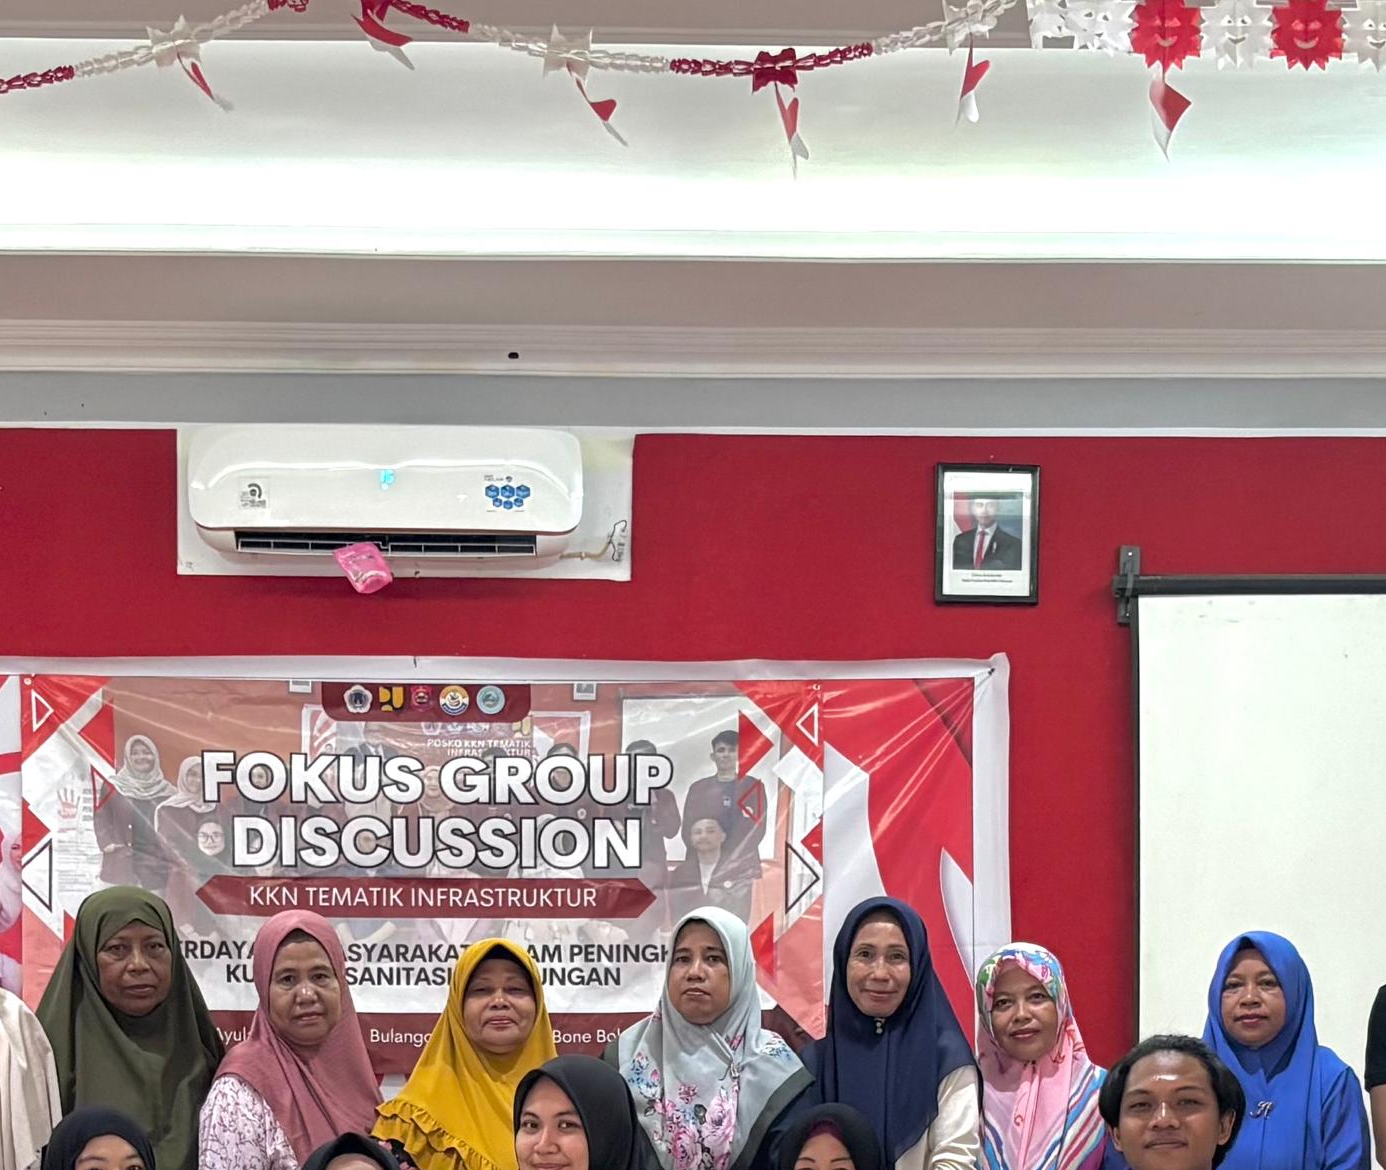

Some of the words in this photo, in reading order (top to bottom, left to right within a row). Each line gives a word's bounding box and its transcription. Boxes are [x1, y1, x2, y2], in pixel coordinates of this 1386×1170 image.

[427, 739, 462, 748] POSKO
[464, 740, 486, 748] KKN
[487, 740, 531, 748] TEMATIK
[202, 750, 425, 804] FOKUS
[439, 753, 673, 806] GROUP
[232, 815, 643, 871] DISCUSSION
[250, 886, 299, 907] KKN
[305, 886, 404, 908] TEMATIK
[411, 887, 597, 909] INFRASTRUKTUR
[553, 1029, 592, 1044] Bone
